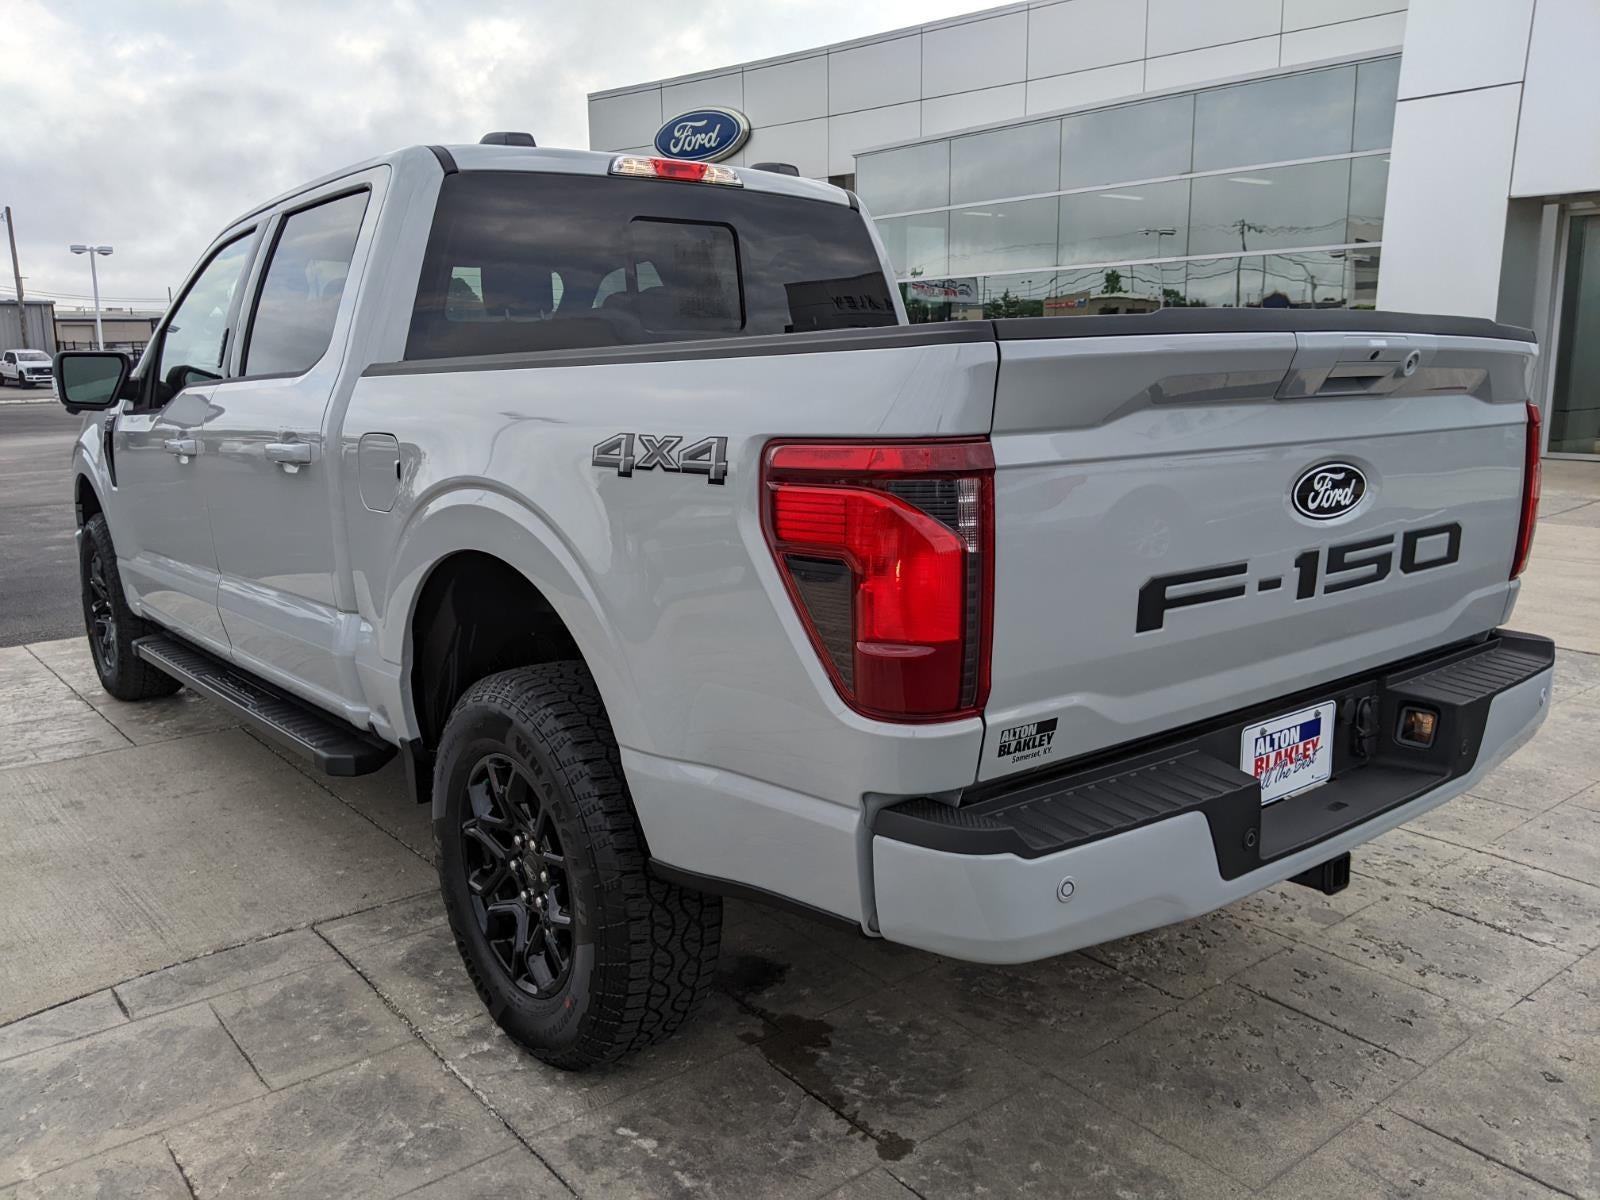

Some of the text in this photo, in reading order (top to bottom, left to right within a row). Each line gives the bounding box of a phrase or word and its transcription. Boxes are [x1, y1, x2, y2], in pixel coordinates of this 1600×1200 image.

[670, 119, 721, 154] Ford
[1308, 472, 1356, 510] Ford
[1135, 521, 1462, 634] F-150
[998, 732, 1055, 759] BLAKLEY
[1001, 723, 1038, 744] ALTON
[1255, 725, 1300, 757] ALTON
[1254, 736, 1321, 780] BLAKLEY
